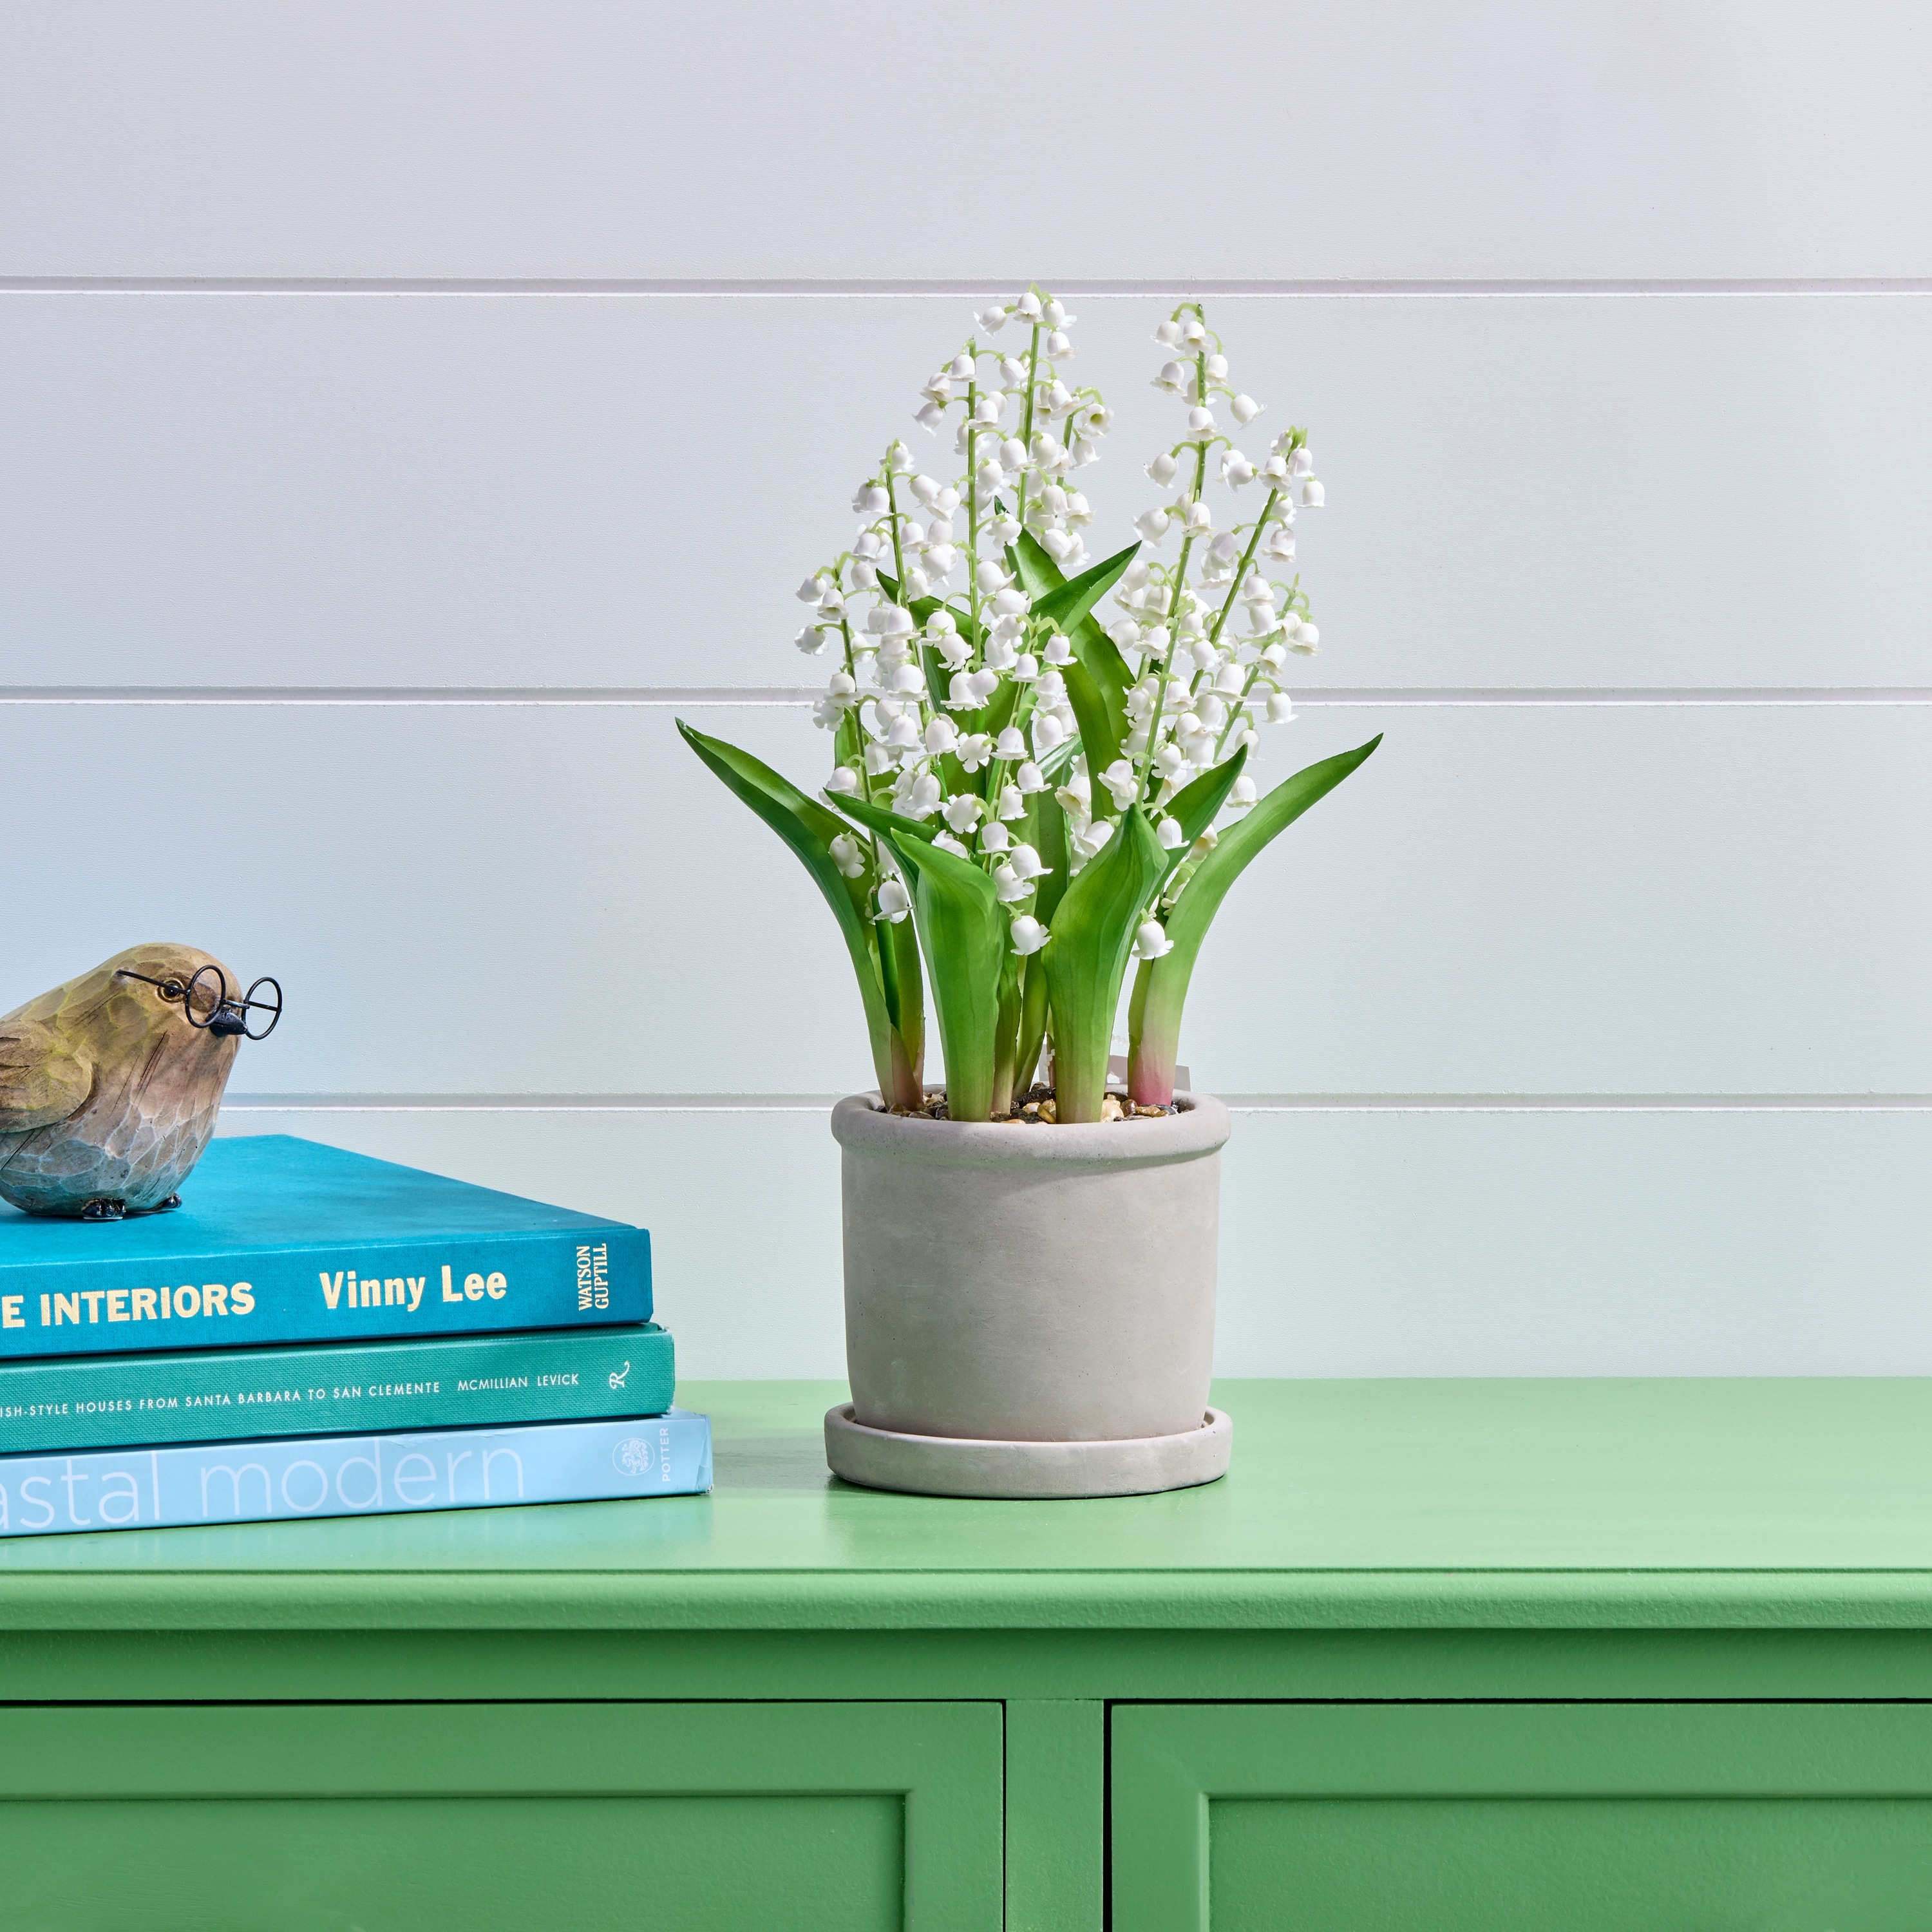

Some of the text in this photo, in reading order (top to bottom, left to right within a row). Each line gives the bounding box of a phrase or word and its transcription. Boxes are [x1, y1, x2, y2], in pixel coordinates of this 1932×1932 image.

[319, 1265, 507, 1311] Vinny Lee
[576, 1245, 592, 1311] WATSON
[593, 1243, 609, 1309] GUPTILL
[2, 1282, 255, 1328] E INTERIORS
[76, 1399, 133, 1414] HOUSES
[139, 1397, 178, 1409] FROM
[185, 1394, 231, 1406] SANTA
[238, 1389, 301, 1404] BARBARA
[308, 1388, 325, 1399] TO
[333, 1386, 361, 1397] SAN
[369, 1381, 440, 1396] CLEMENTE
[458, 1373, 579, 1392] MCMILLIAN LEVICK
[660, 1428, 671, 1482] POTTER
[0, 1436, 524, 1530] stal modern
